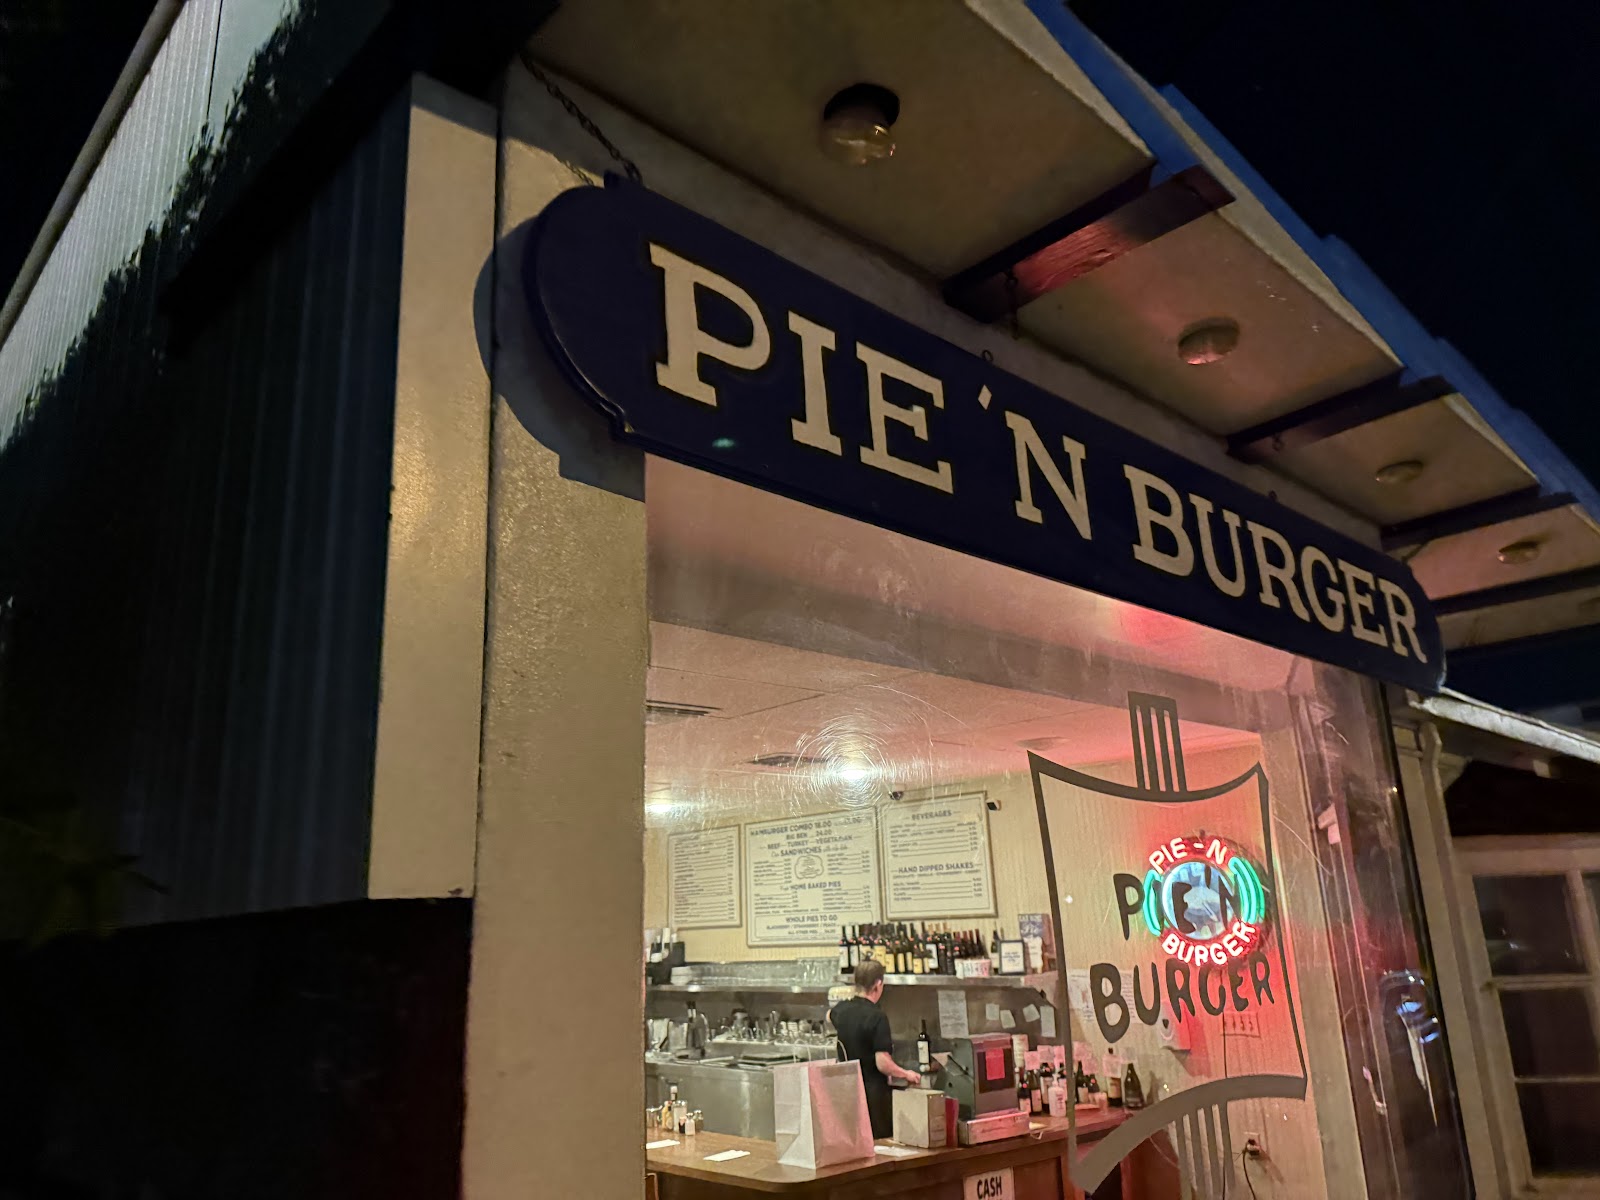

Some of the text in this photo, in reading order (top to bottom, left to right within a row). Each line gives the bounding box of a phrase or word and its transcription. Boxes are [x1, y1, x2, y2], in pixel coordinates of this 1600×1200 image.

[649, 241, 954, 495] PIE
[1122, 464, 1429, 664] BURGER
[911, 809, 953, 821] BEVERAGES
[750, 826, 788, 836] HAMBURGER
[789, 823, 814, 832] COMBO
[780, 847, 822, 857] SANDWICHES
[898, 861, 974, 874] HAND DIPPED SHAKES
[790, 882, 807, 890] HOME
[807, 881, 828, 890] BAKED
[828, 880, 842, 888] PIES
[785, 916, 806, 924] WHOLE
[819, 914, 828, 922] TO
[1161, 920, 1256, 967] BURGER
[1089, 952, 1275, 1044] BURGER
[976, 1175, 1003, 1200] CASH
